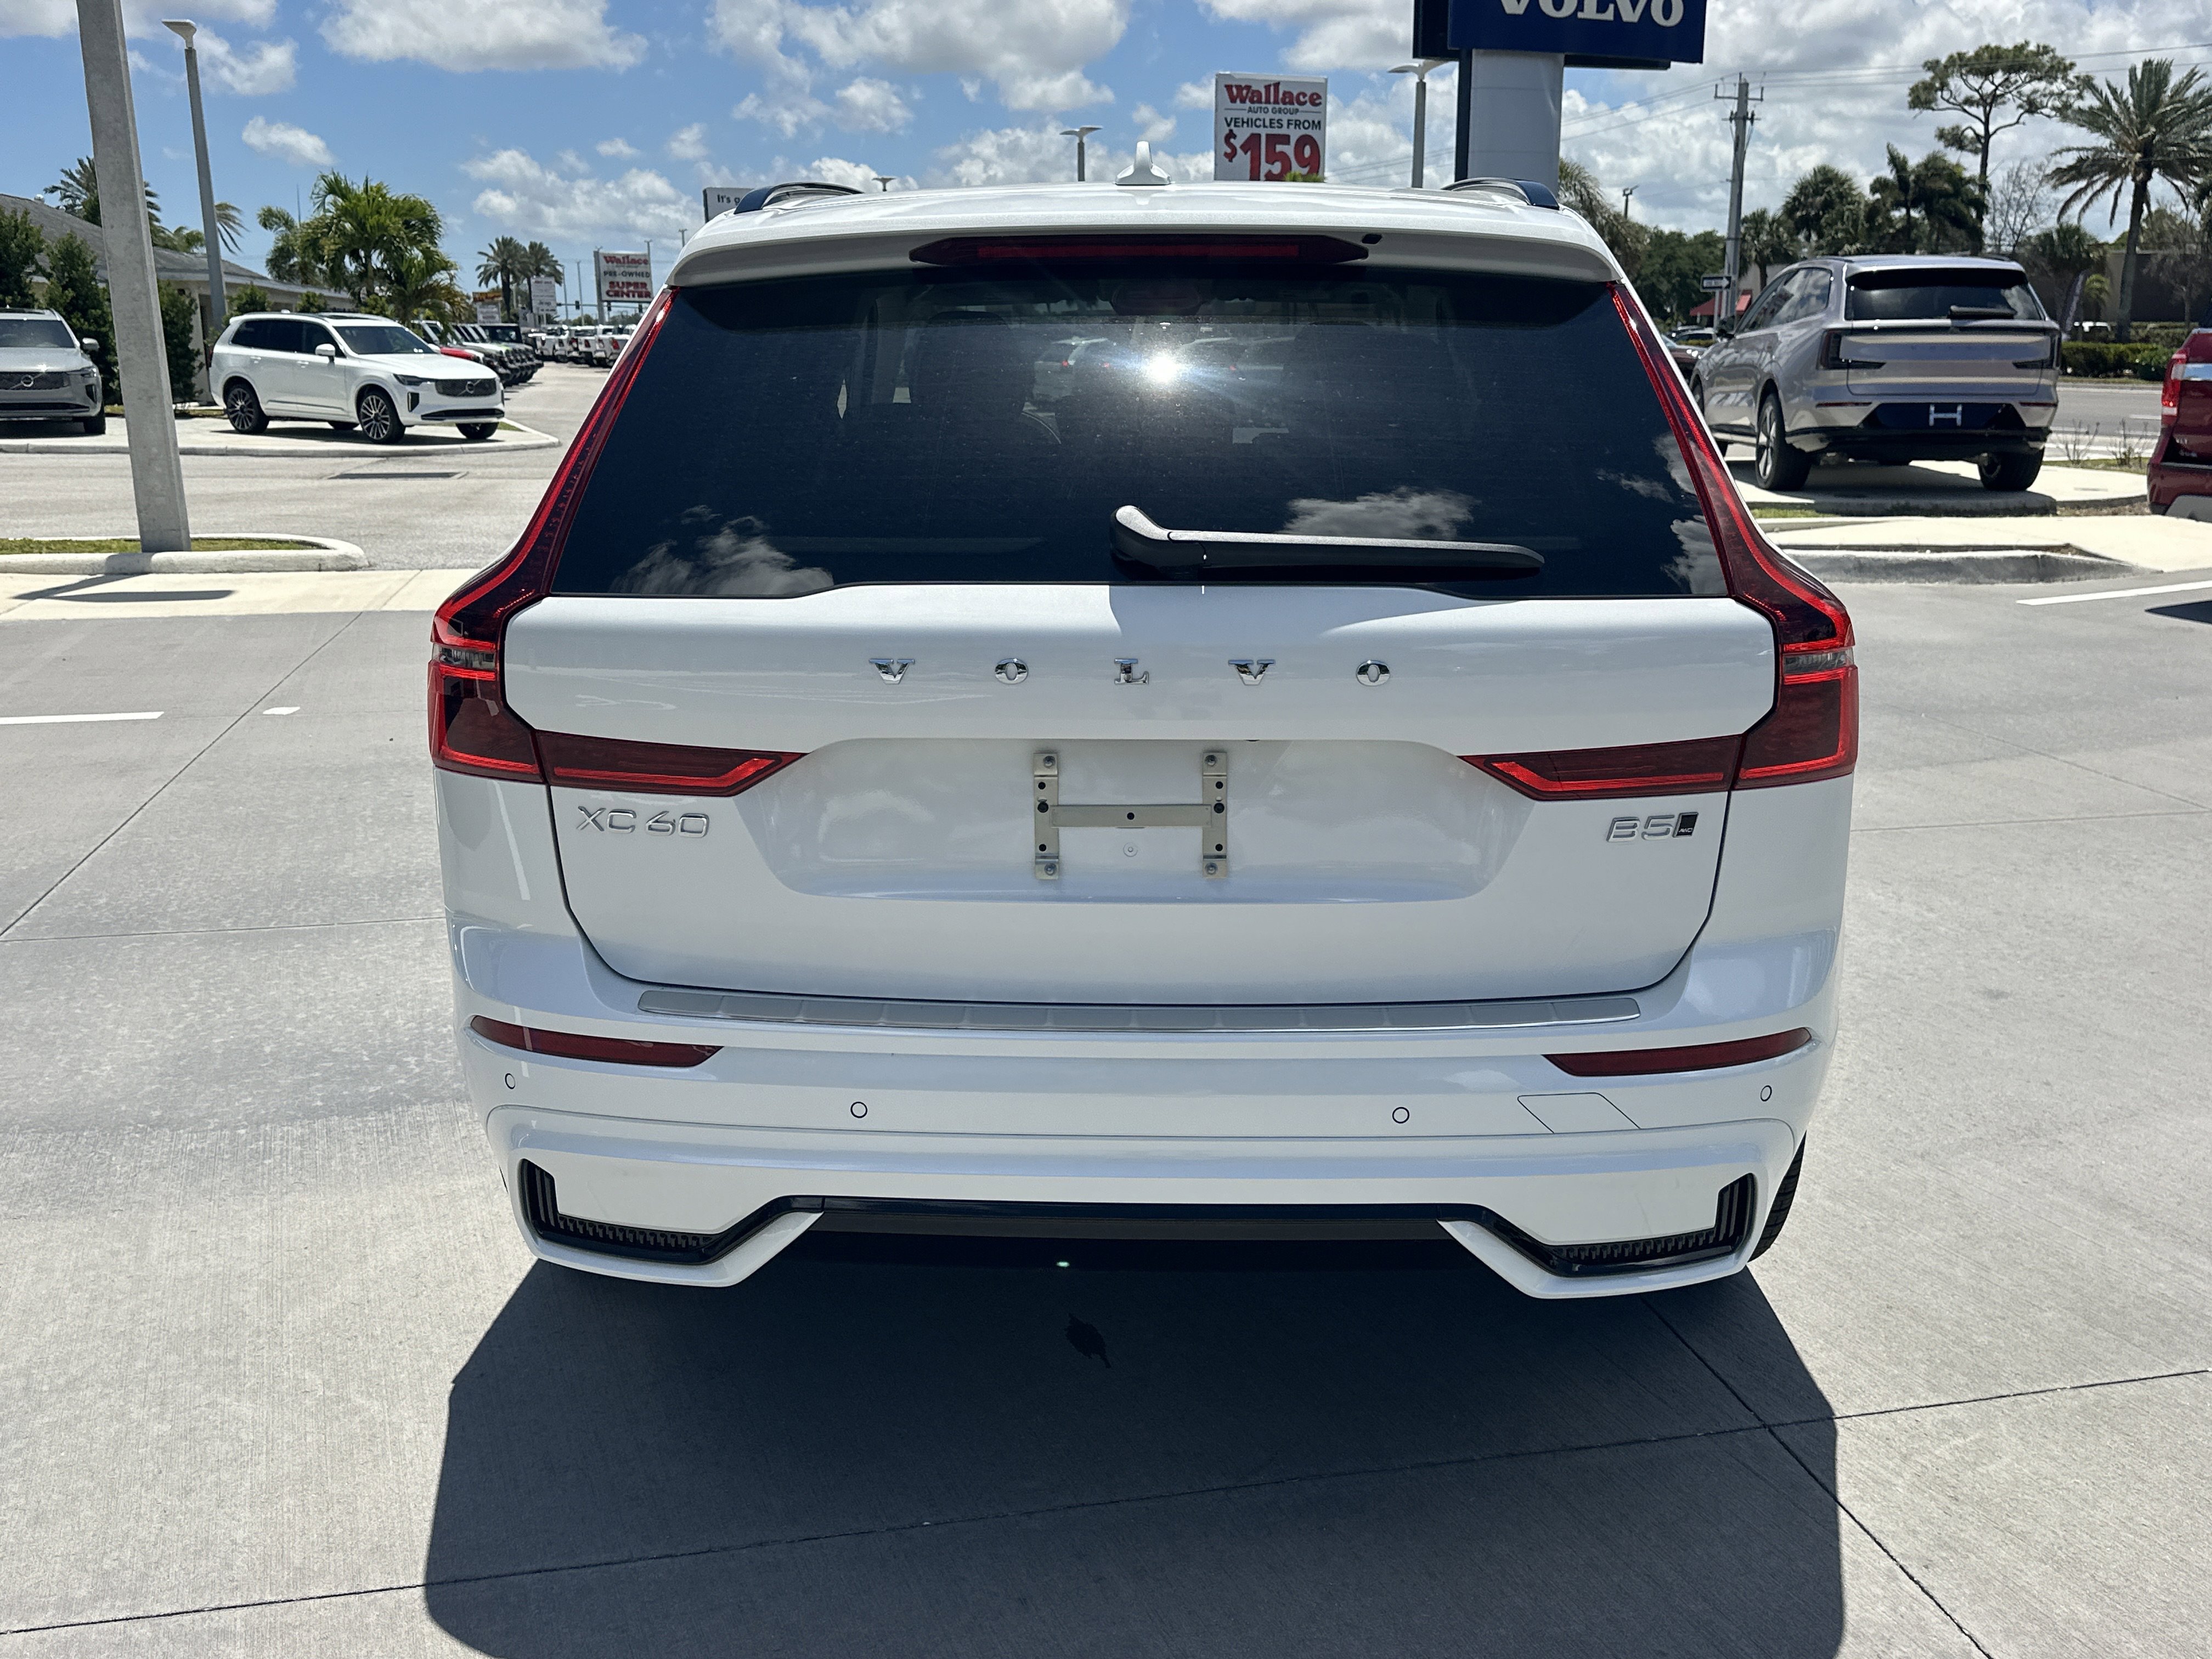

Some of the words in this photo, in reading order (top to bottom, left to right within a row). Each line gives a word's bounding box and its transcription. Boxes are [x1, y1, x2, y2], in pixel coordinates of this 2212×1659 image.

[1224, 82, 1322, 107] Wallace
[1247, 106, 1269, 115] AUTO
[1271, 107, 1300, 115] GROUP
[1224, 117, 1284, 129] VEHICLES
[1287, 119, 1322, 131] FROM
[1223, 129, 1321, 182] $159
[603, 255, 648, 265] Wallace
[609, 280, 647, 290] SUPER
[605, 289, 651, 298] CENTER
[868, 657, 1392, 686] VOLVO
[1606, 814, 1675, 843] B5
